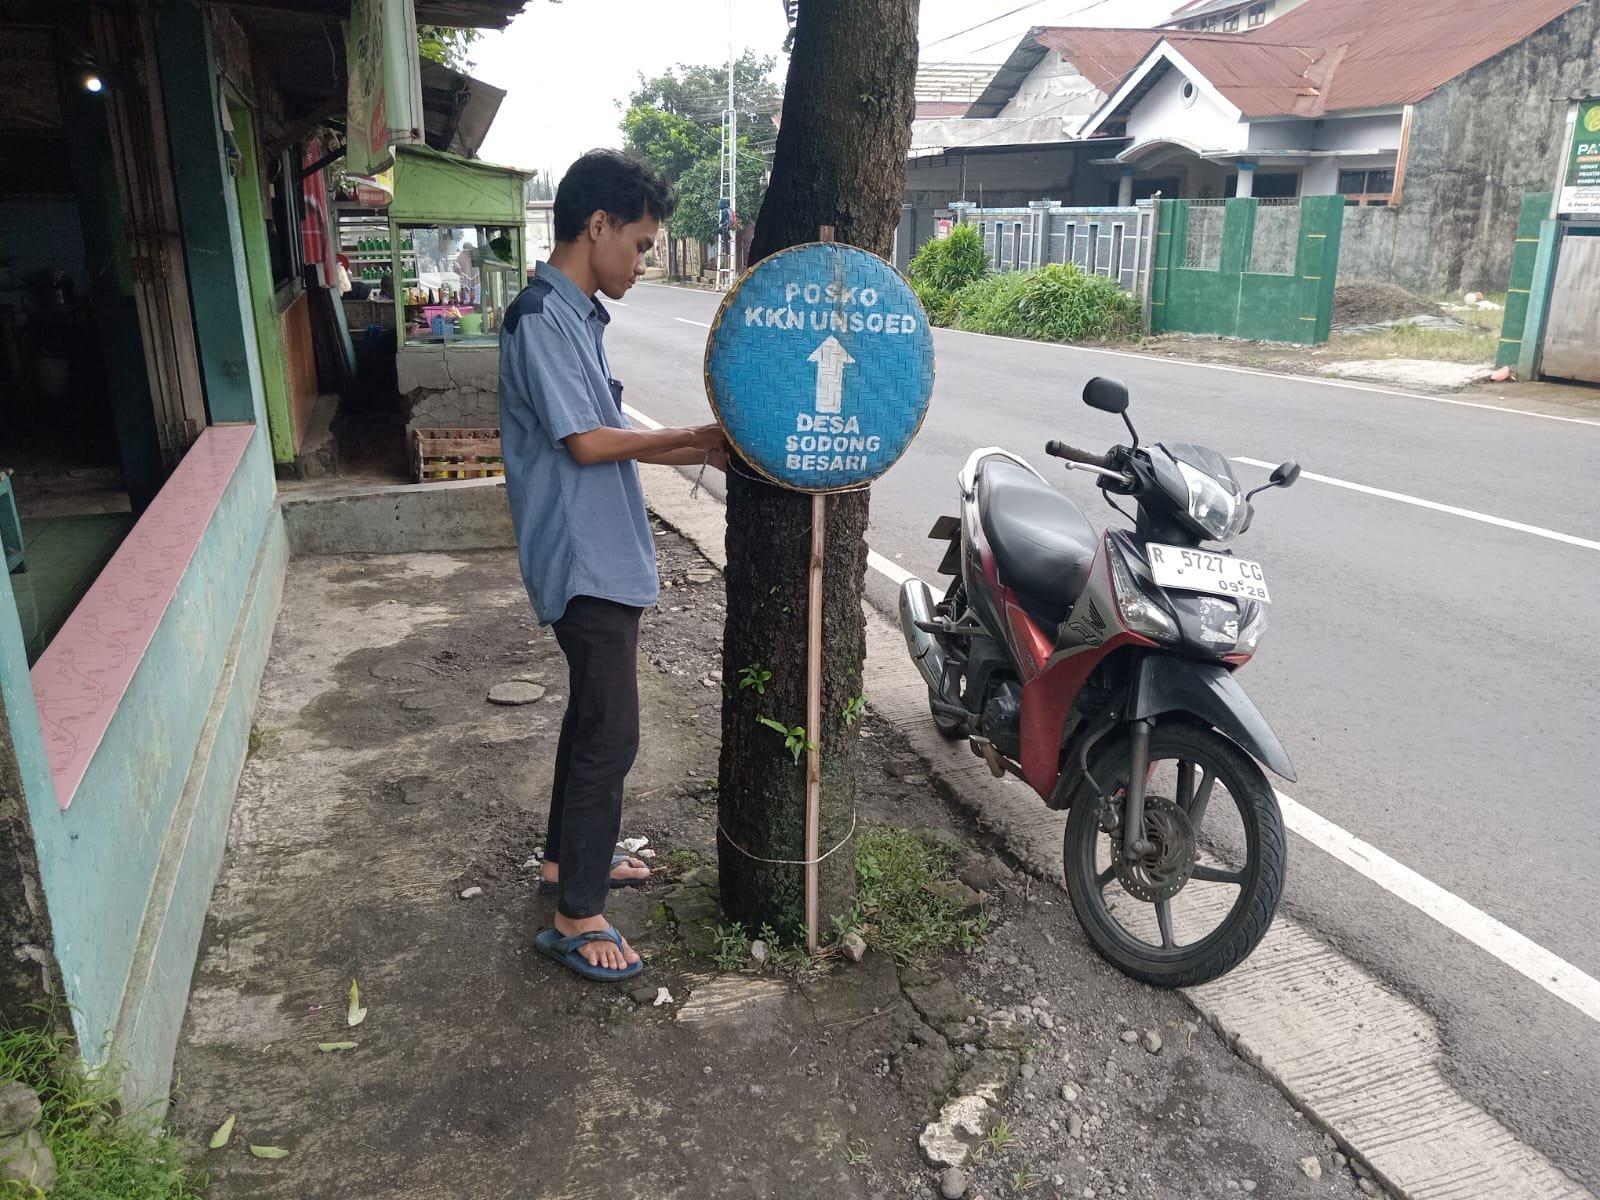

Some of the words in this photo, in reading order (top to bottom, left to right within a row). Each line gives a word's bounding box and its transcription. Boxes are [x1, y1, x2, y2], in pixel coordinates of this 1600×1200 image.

[1577, 143, 1600, 155] PA
[785, 283, 878, 306] POSKO
[745, 305, 805, 331] KKN
[811, 311, 916, 334] UNSOED
[796, 412, 860, 434] DESA
[785, 434, 881, 452] SODONG
[786, 454, 868, 472] BESARI
[1152, 546, 1165, 564] R
[1181, 551, 1224, 574] 5727
[1239, 562, 1263, 581] CG
